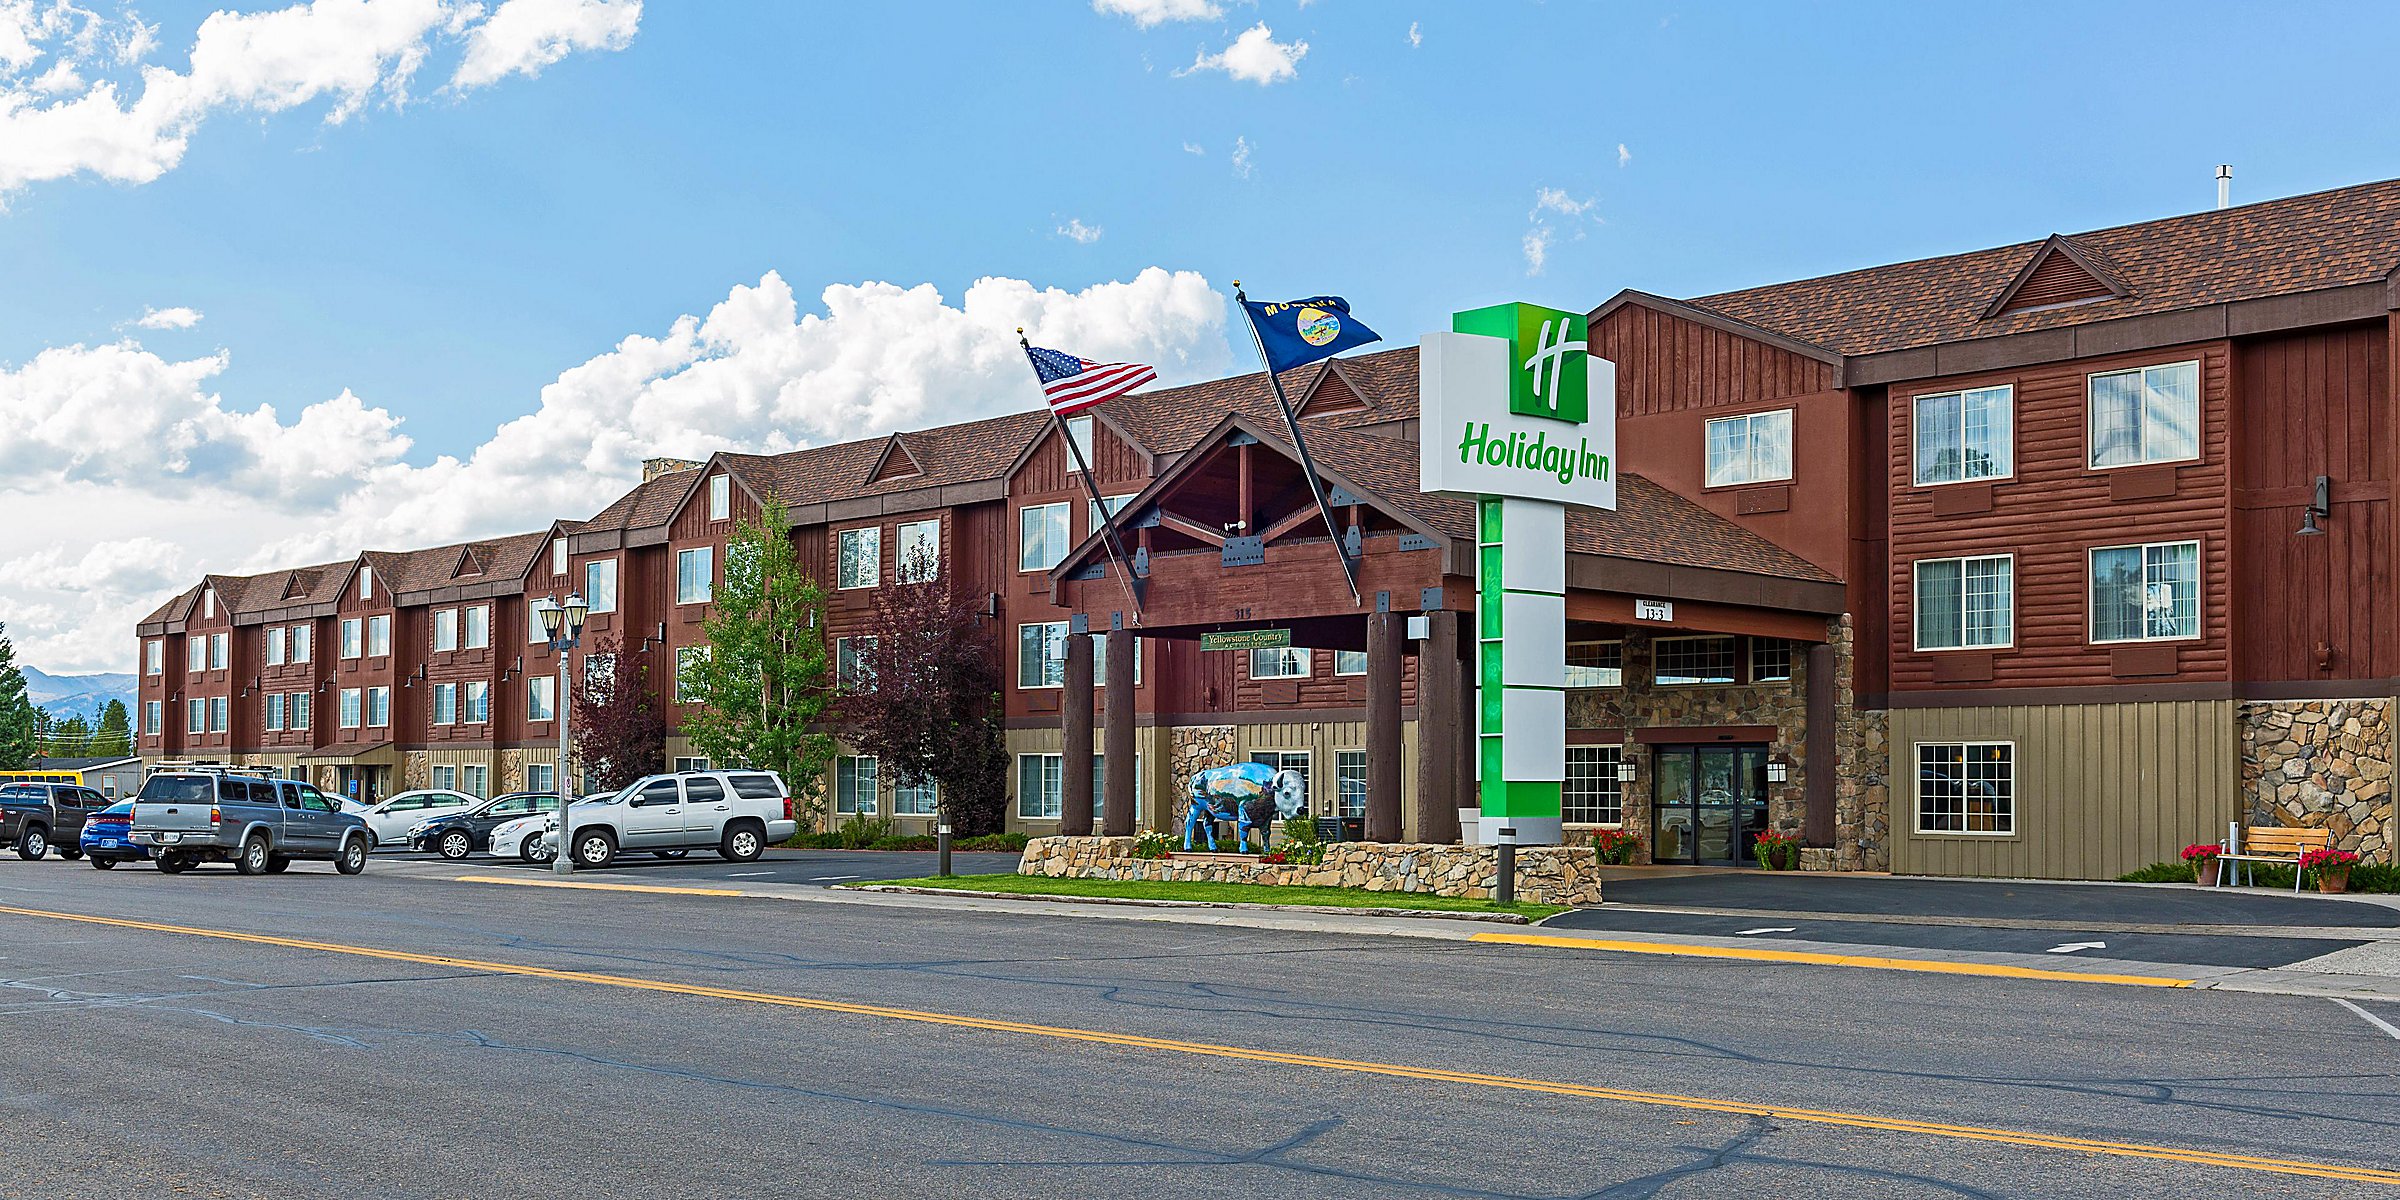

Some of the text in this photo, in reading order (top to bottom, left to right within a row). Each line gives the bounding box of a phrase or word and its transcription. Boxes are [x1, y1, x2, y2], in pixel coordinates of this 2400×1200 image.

[1458, 422, 1610, 485] Holiday Inn
[1234, 607, 1252, 619] 315
[1208, 632, 1284, 644] Yellowstone Country
